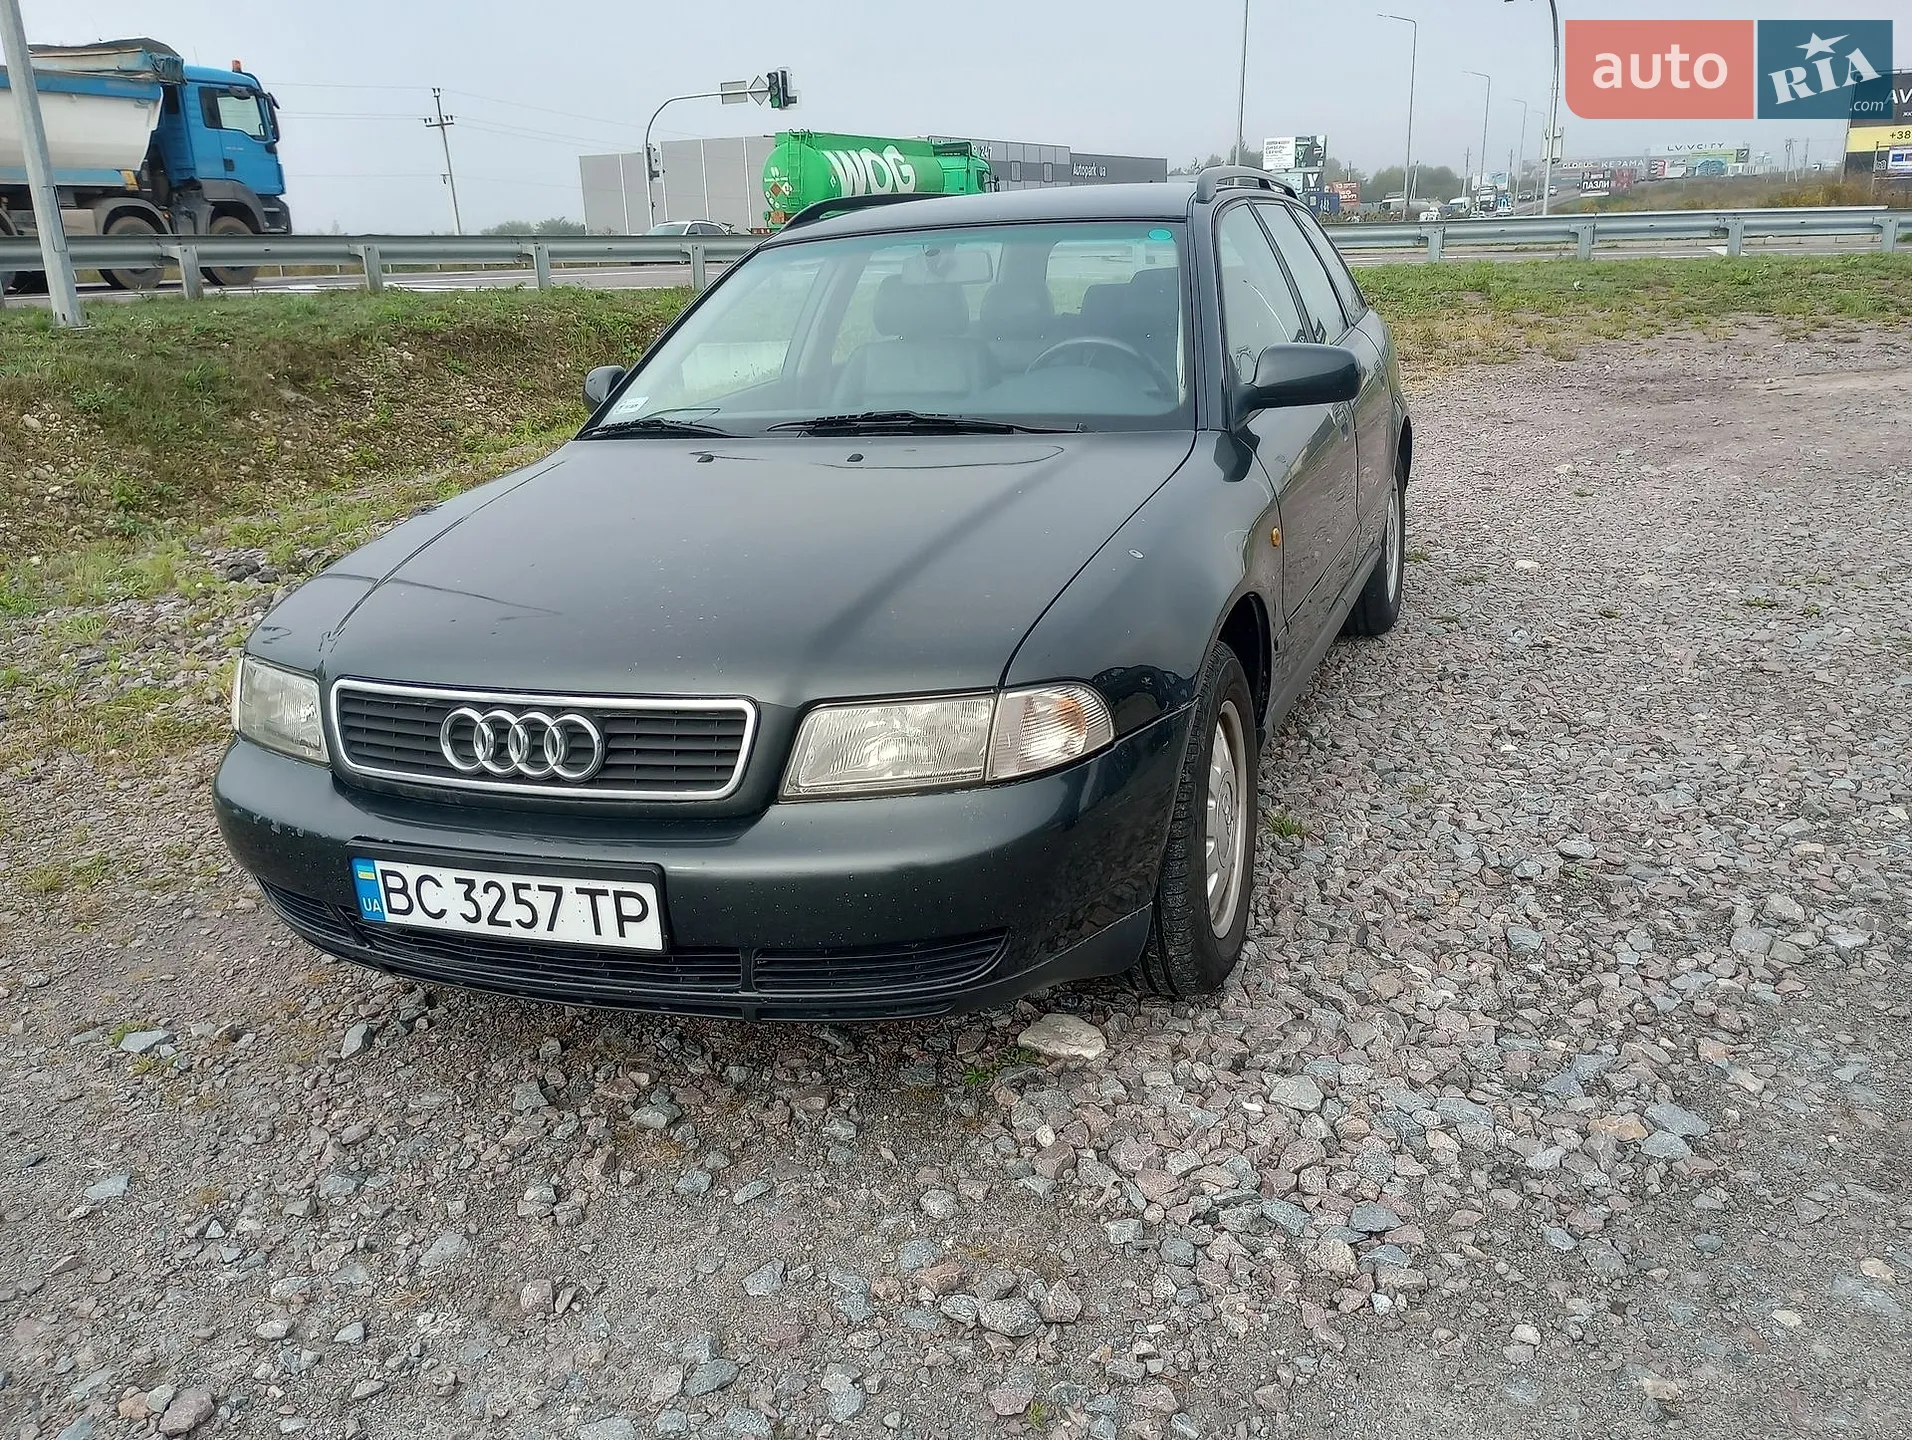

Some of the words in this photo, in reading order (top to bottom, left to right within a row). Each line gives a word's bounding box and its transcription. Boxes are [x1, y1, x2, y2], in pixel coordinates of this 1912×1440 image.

[821, 145, 917, 197] WOG
[362, 897, 383, 914] UA
[380, 868, 448, 920] BC
[453, 876, 563, 932] 3257
[575, 886, 650, 939] TP
